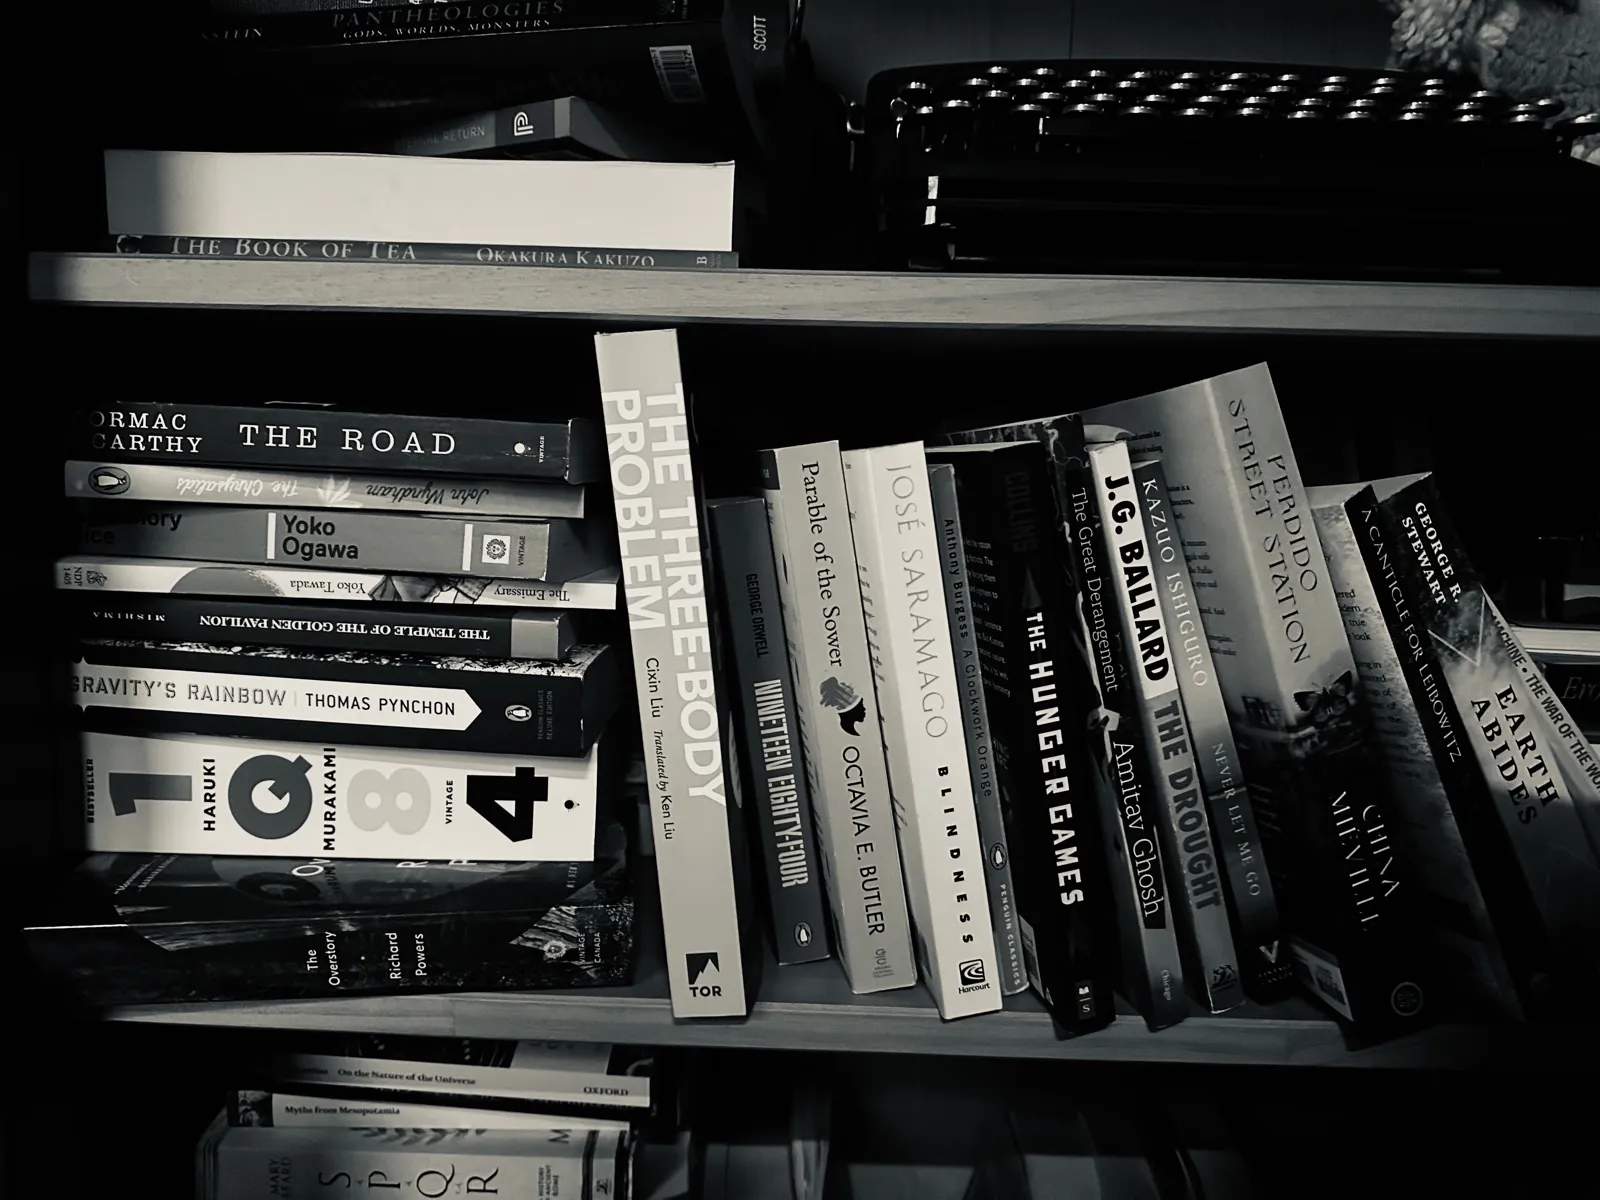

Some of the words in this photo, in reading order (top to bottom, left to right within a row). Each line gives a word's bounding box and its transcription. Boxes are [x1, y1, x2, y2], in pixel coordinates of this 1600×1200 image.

[331, 0, 565, 28] PANTHEOLOGIES
[342, 29, 388, 40] GODS,
[395, 25, 461, 37] WORLDS,
[467, 18, 553, 33] MONSTERS
[752, 14, 767, 51] SCOTT
[168, 236, 221, 256] THE
[233, 238, 309, 258] BOOK
[321, 241, 354, 259] OF
[366, 241, 418, 261] TEA
[476, 246, 568, 265] OKAKURA
[576, 250, 655, 267] KAKUZO
[239, 423, 318, 450] THE
[340, 427, 457, 455] ROAD
[646, 382, 693, 485] THE
[176, 473, 263, 497] Chrysalids
[272, 484, 298, 498] The
[365, 480, 445, 505] Wyndham
[450, 488, 490, 505] John
[802, 460, 828, 535] Parable
[886, 464, 926, 534] JOSÉ
[1071, 487, 1089, 523] The
[1105, 475, 1136, 535] J.G.
[282, 514, 335, 536] Yoko
[601, 389, 666, 631] PROBLEM
[1267, 454, 1318, 592] PERDIDO
[282, 536, 359, 561] Ogawa
[517, 535, 526, 567] VINTAGE
[944, 518, 960, 576] Anthony
[1078, 525, 1097, 574] Great
[1228, 398, 1273, 519] STREET
[1263, 533, 1311, 664] STATION
[813, 541, 834, 563] of
[1401, 515, 1448, 605] STEWART
[1414, 501, 1454, 580] GEORGE
[1449, 581, 1463, 604] R.
[289, 579, 335, 593] Tawada
[335, 582, 366, 594] Yoko
[493, 584, 546, 601] Emissary
[548, 590, 570, 602] The
[746, 573, 763, 616] GEORGE
[816, 567, 836, 600] the
[1142, 477, 1176, 563] KAZUO
[1166, 572, 1208, 687] ISHIGURO
[92, 611, 166, 622] MISHIMA
[199, 614, 269, 630] PAVILION
[271, 619, 334, 632] GOLDEN
[336, 622, 368, 634] THE
[370, 624, 392, 635] OF
[953, 581, 969, 638] Burgess
[1119, 539, 1169, 681] BALLARD
[394, 625, 457, 639] TEMPLE
[458, 628, 491, 641] THE
[659, 496, 728, 807] THREE-BODY
[752, 617, 769, 659] ORWELL
[823, 605, 842, 668] Sower
[901, 549, 948, 738] SARAMAGO
[1026, 611, 1047, 652] THE
[1087, 577, 1118, 693] Derangement
[1361, 508, 1373, 523] A
[1369, 525, 1411, 625] CANTICLE
[1403, 622, 1425, 663] FOR
[1418, 662, 1462, 764] LEIBOWITZ
[646, 657, 662, 693] Cixin
[963, 650, 973, 659] A
[70, 674, 177, 699] GRAVITY'S
[187, 683, 286, 707] RAINBOW
[305, 693, 371, 711] THOMAS
[379, 698, 456, 716] PYNCHON
[650, 698, 664, 718] Liu
[965, 664, 984, 739] Clockwork
[1492, 614, 1527, 667] ACHINE
[1525, 672, 1548, 700] THE
[1540, 696, 1564, 725] WAR
[1558, 723, 1577, 741] OF
[1570, 739, 1592, 766] THE
[754, 679, 793, 772] NINETEEN
[1028, 660, 1070, 796] HUNGER
[1154, 699, 1189, 761] THE
[1495, 684, 1561, 807] EARTH
[653, 728, 668, 778] Translated
[977, 745, 992, 797] Orange
[1211, 742, 1237, 800] NEVER
[1470, 699, 1539, 825] ABIDES
[86, 758, 95, 824] BESTSELLER
[203, 758, 216, 832] HARUKI
[323, 747, 336, 851] MURAKAMI
[444, 779, 454, 825] VINTAGE
[655, 778, 669, 792] by
[842, 745, 871, 837] OCTAVIA
[660, 794, 672, 819] Ken
[1228, 803, 1247, 835] LET
[664, 821, 675, 840] Liu
[767, 774, 810, 889] EIGHTY-FOUR
[1112, 740, 1144, 832] Amitav
[1132, 837, 1165, 918] Ghosh
[1168, 766, 1221, 910] DROUGHT
[856, 842, 874, 861] E.
[938, 766, 974, 943] BLINDNESS
[1049, 802, 1085, 906] GAMES
[1237, 840, 1253, 867] ME
[860, 865, 885, 936] BUTLER
[1245, 870, 1261, 897] GO
[384, 931, 402, 980] Richard
[414, 931, 427, 977] Powers
[1000, 884, 1012, 930] PENGUIN
[1007, 934, 1020, 986] CLASSICS
[306, 948, 319, 971] The
[324, 930, 341, 987] Overstory
[689, 985, 722, 998] TOR
[957, 982, 991, 995] Harcourt
[337, 1067, 352, 1076] On
[354, 1068, 370, 1079] the
[371, 1070, 403, 1081] Nature
[405, 1072, 417, 1081] of
[417, 1073, 434, 1083] the
[435, 1074, 477, 1086] Universe
[583, 1086, 629, 1097] OXFORD
[285, 1105, 313, 1116] Myths
[314, 1105, 338, 1115] from
[339, 1105, 401, 1118] Mesopotamia
